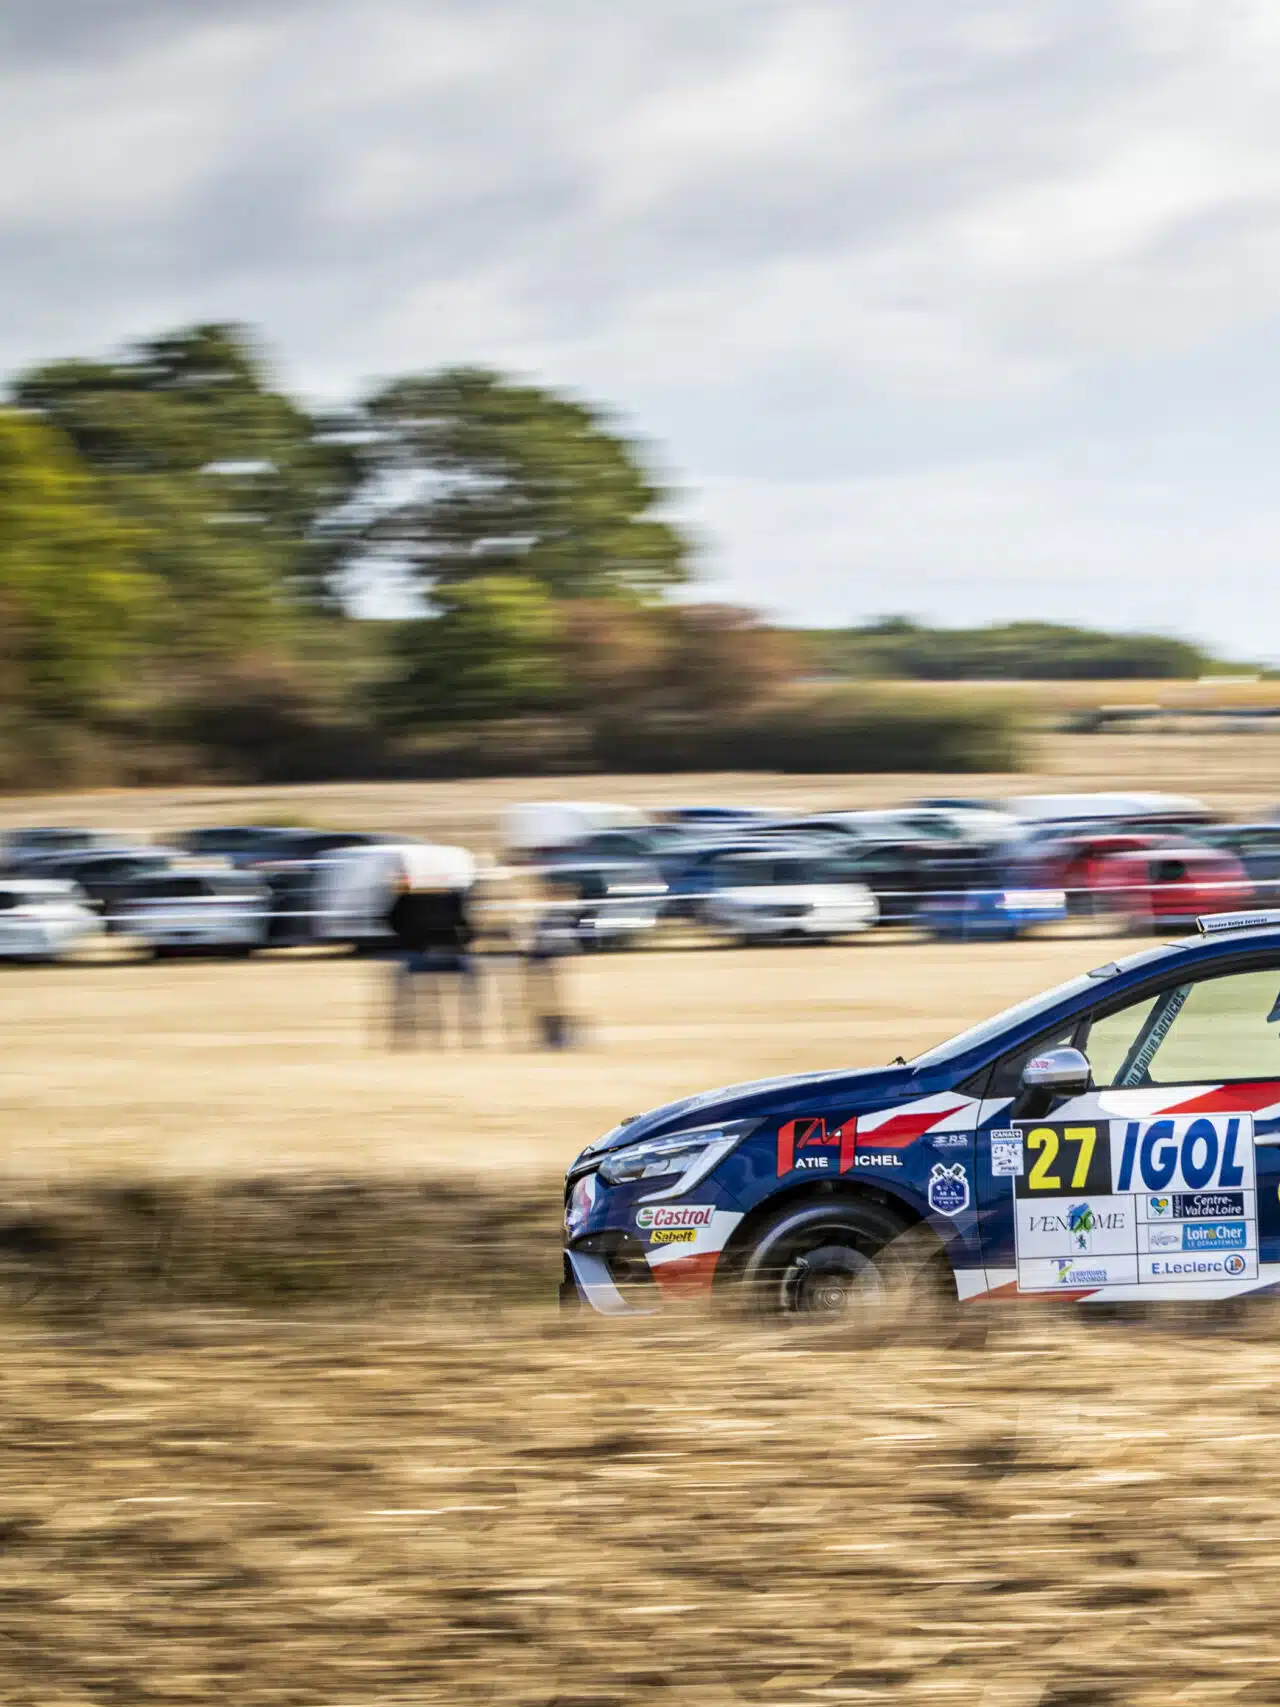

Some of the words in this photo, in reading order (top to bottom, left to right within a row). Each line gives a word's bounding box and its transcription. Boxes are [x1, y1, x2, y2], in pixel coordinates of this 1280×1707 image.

[1027, 1127, 1097, 1191] 27
[1117, 1118, 1244, 1191] IGOL
[654, 1207, 711, 1226] Castrol
[654, 1230, 693, 1242] Sabelt
[1152, 1261, 1222, 1275] E.Leclerc
